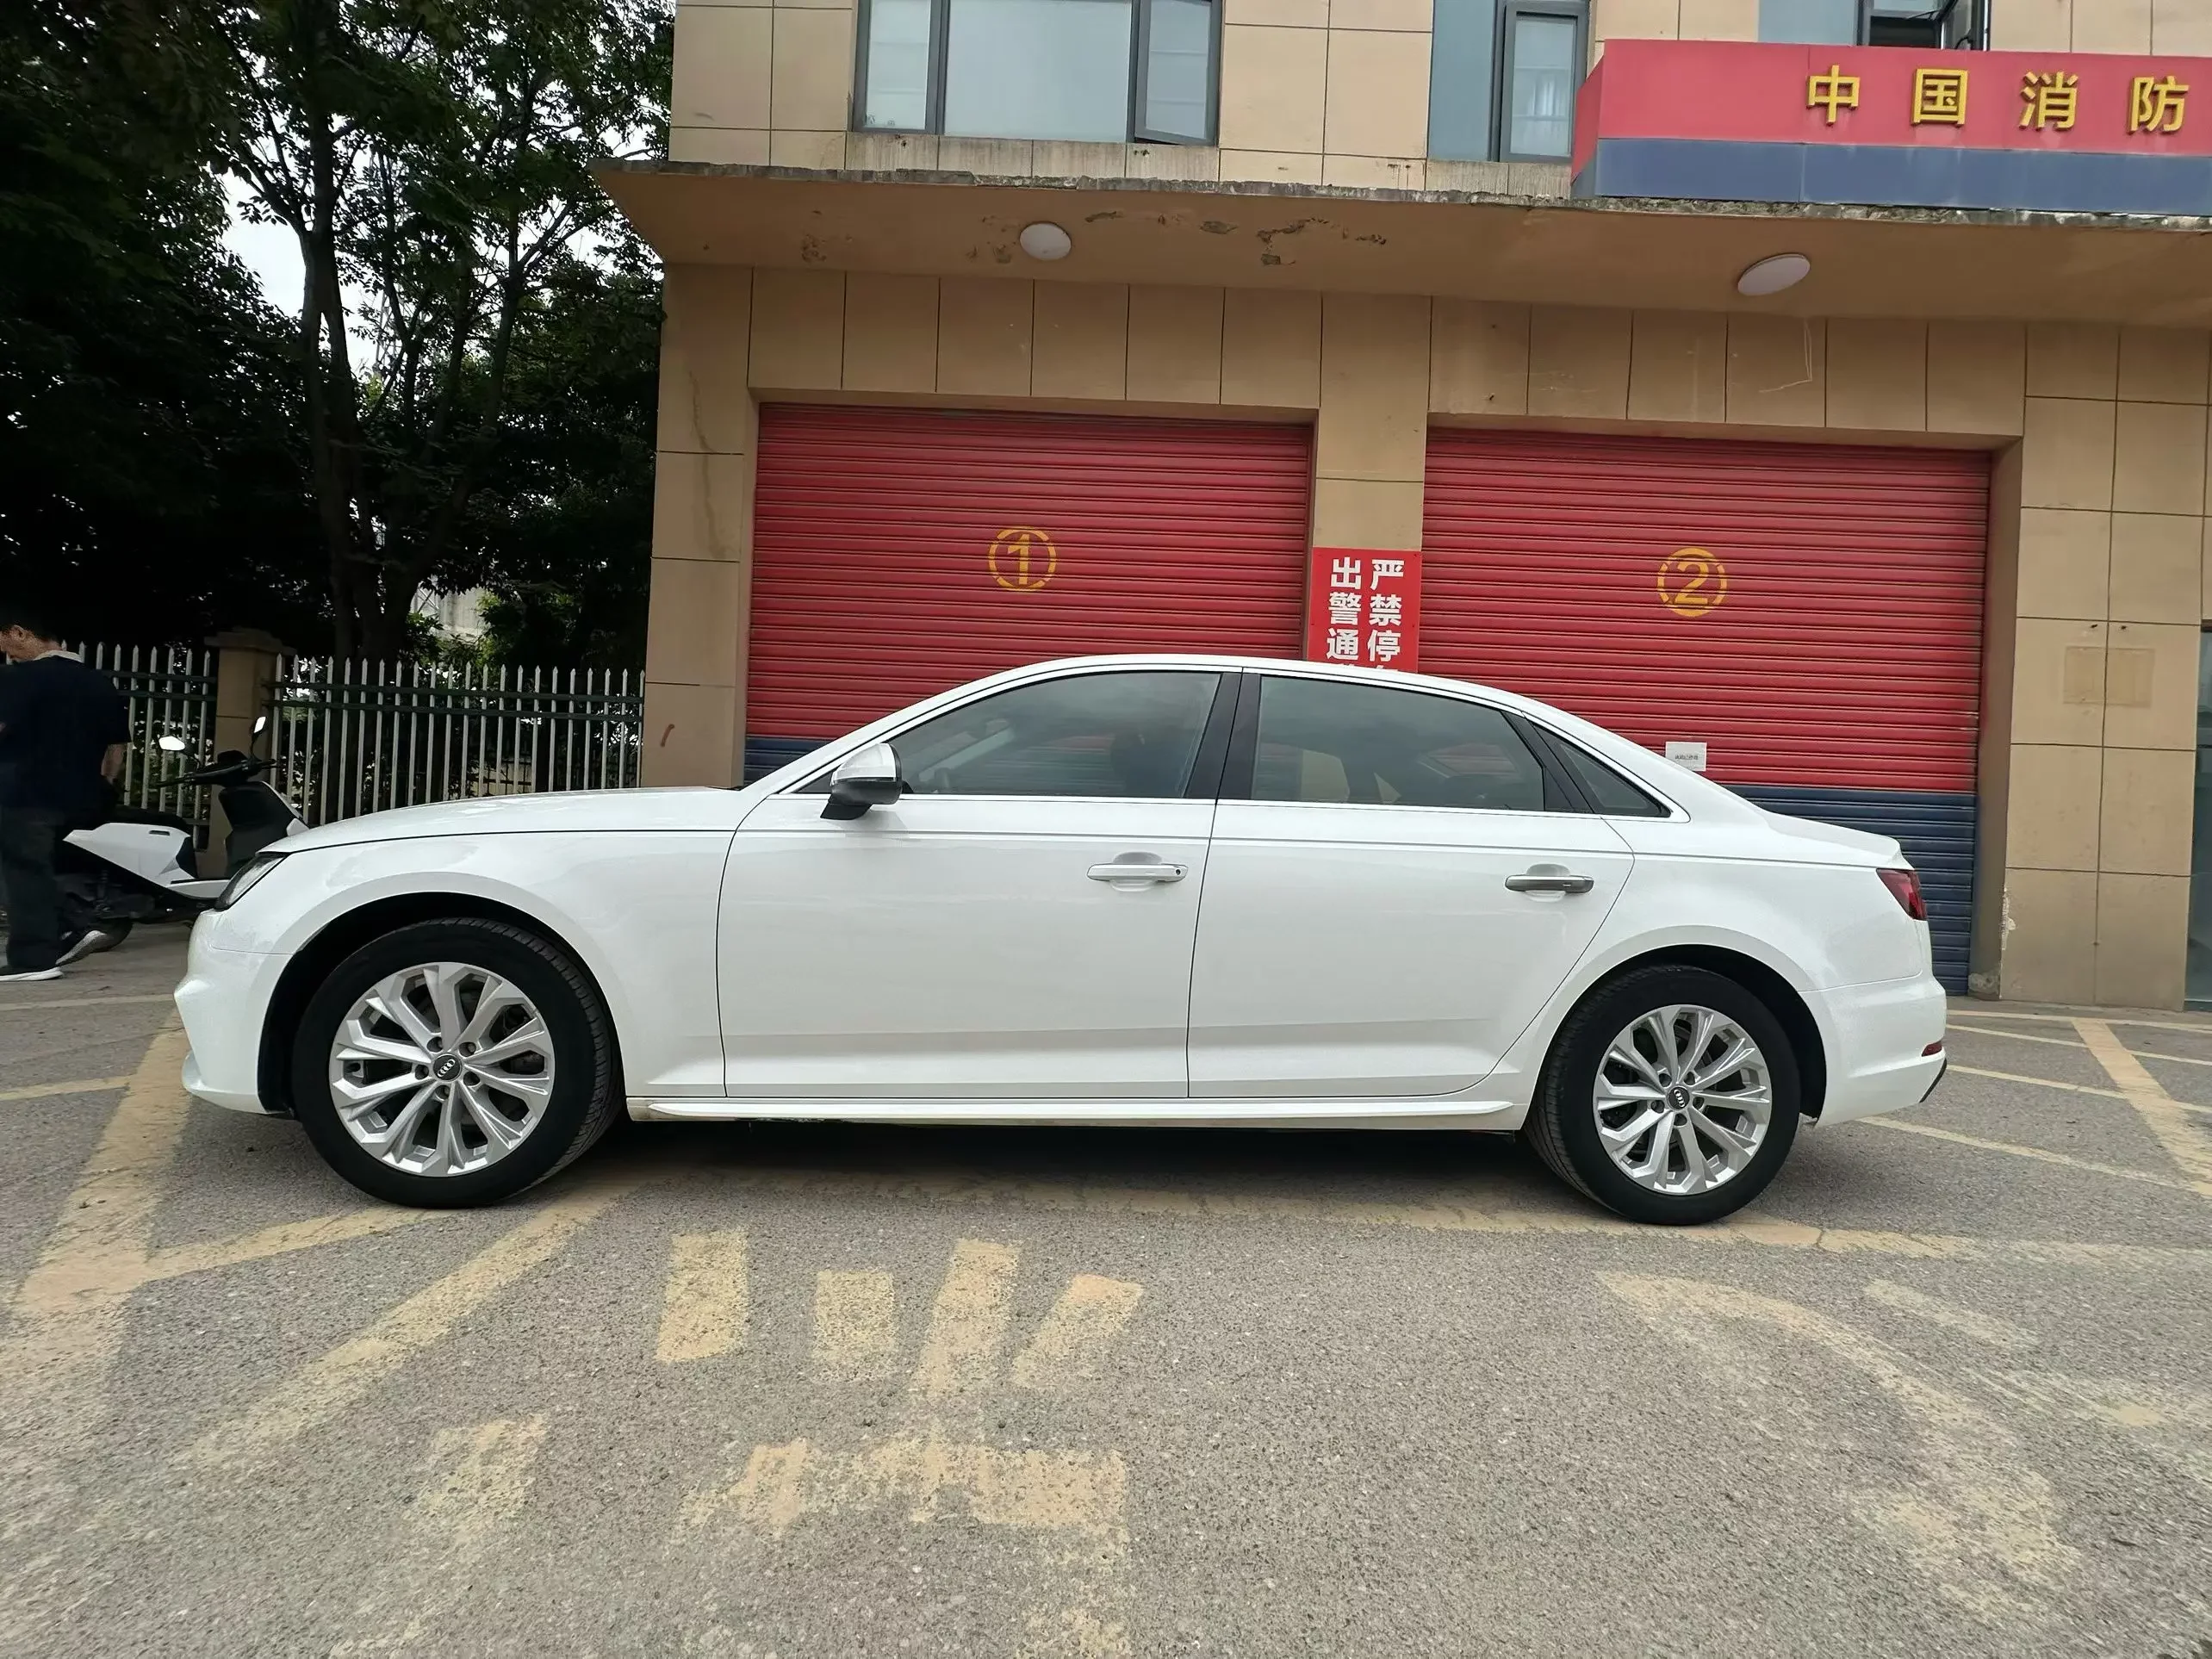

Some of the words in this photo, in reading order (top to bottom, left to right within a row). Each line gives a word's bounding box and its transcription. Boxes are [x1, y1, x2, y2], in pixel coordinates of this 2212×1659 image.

[1807, 65, 2190, 134] 中国消防
[1327, 556, 1362, 668] 出警通
[1367, 559, 1405, 671] 严禁停
